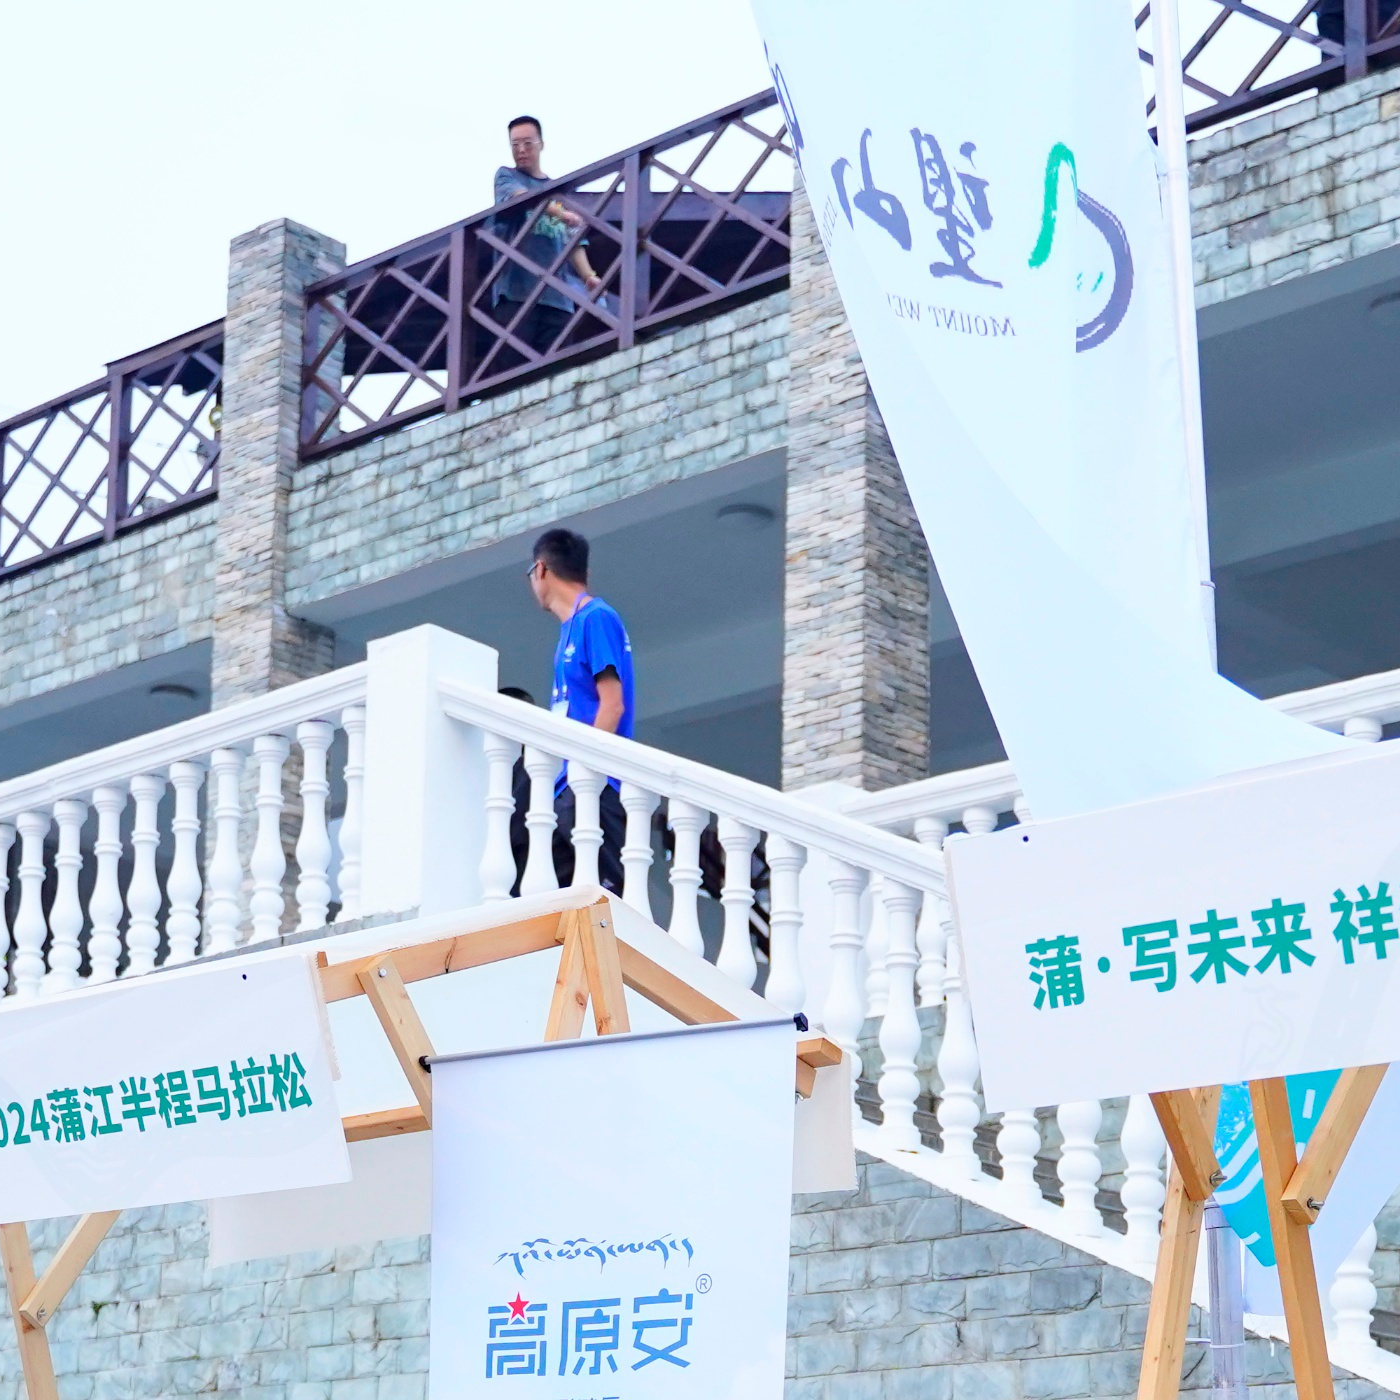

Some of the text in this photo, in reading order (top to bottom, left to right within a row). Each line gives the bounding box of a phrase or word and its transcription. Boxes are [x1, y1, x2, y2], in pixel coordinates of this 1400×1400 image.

[1025, 896, 1316, 1011] 蒲·写未来
[485, 1287, 693, 1378] 高原安
